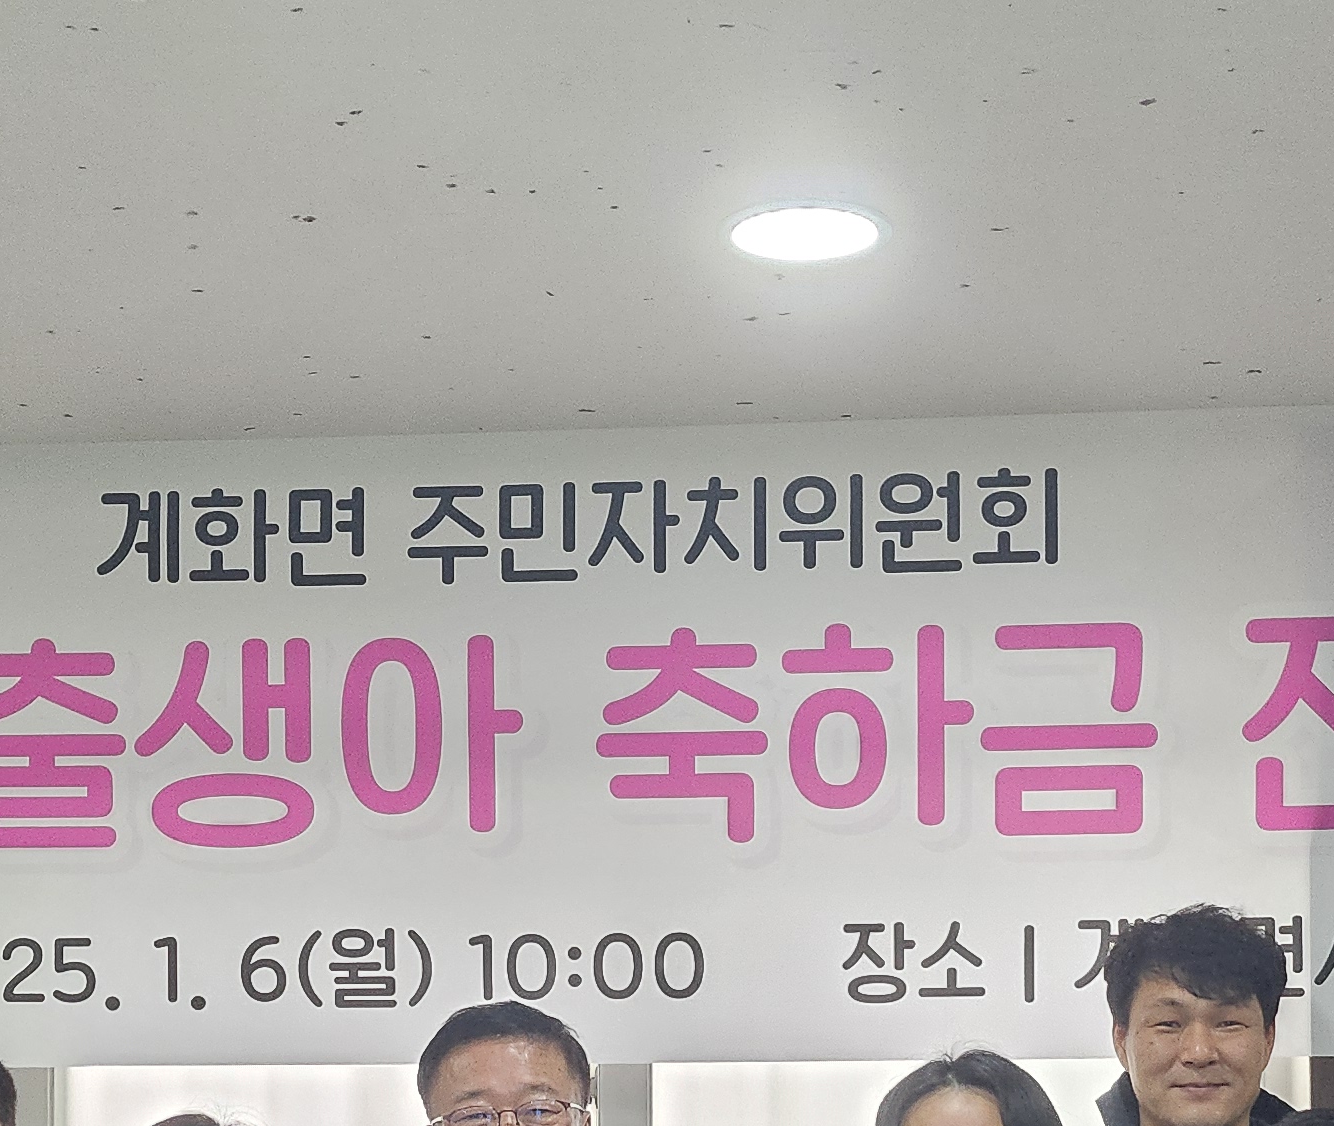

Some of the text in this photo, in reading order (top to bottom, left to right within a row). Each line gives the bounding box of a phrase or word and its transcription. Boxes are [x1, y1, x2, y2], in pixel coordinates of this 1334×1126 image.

[95, 466, 1060, 588] 계화면 주민자치위원회
[595, 622, 1159, 843] 축하금
[152, 935, 208, 1012] 1.
[239, 926, 434, 1010] 6(월)
[467, 931, 706, 1002] 10:00
[841, 919, 987, 1005] 장소
